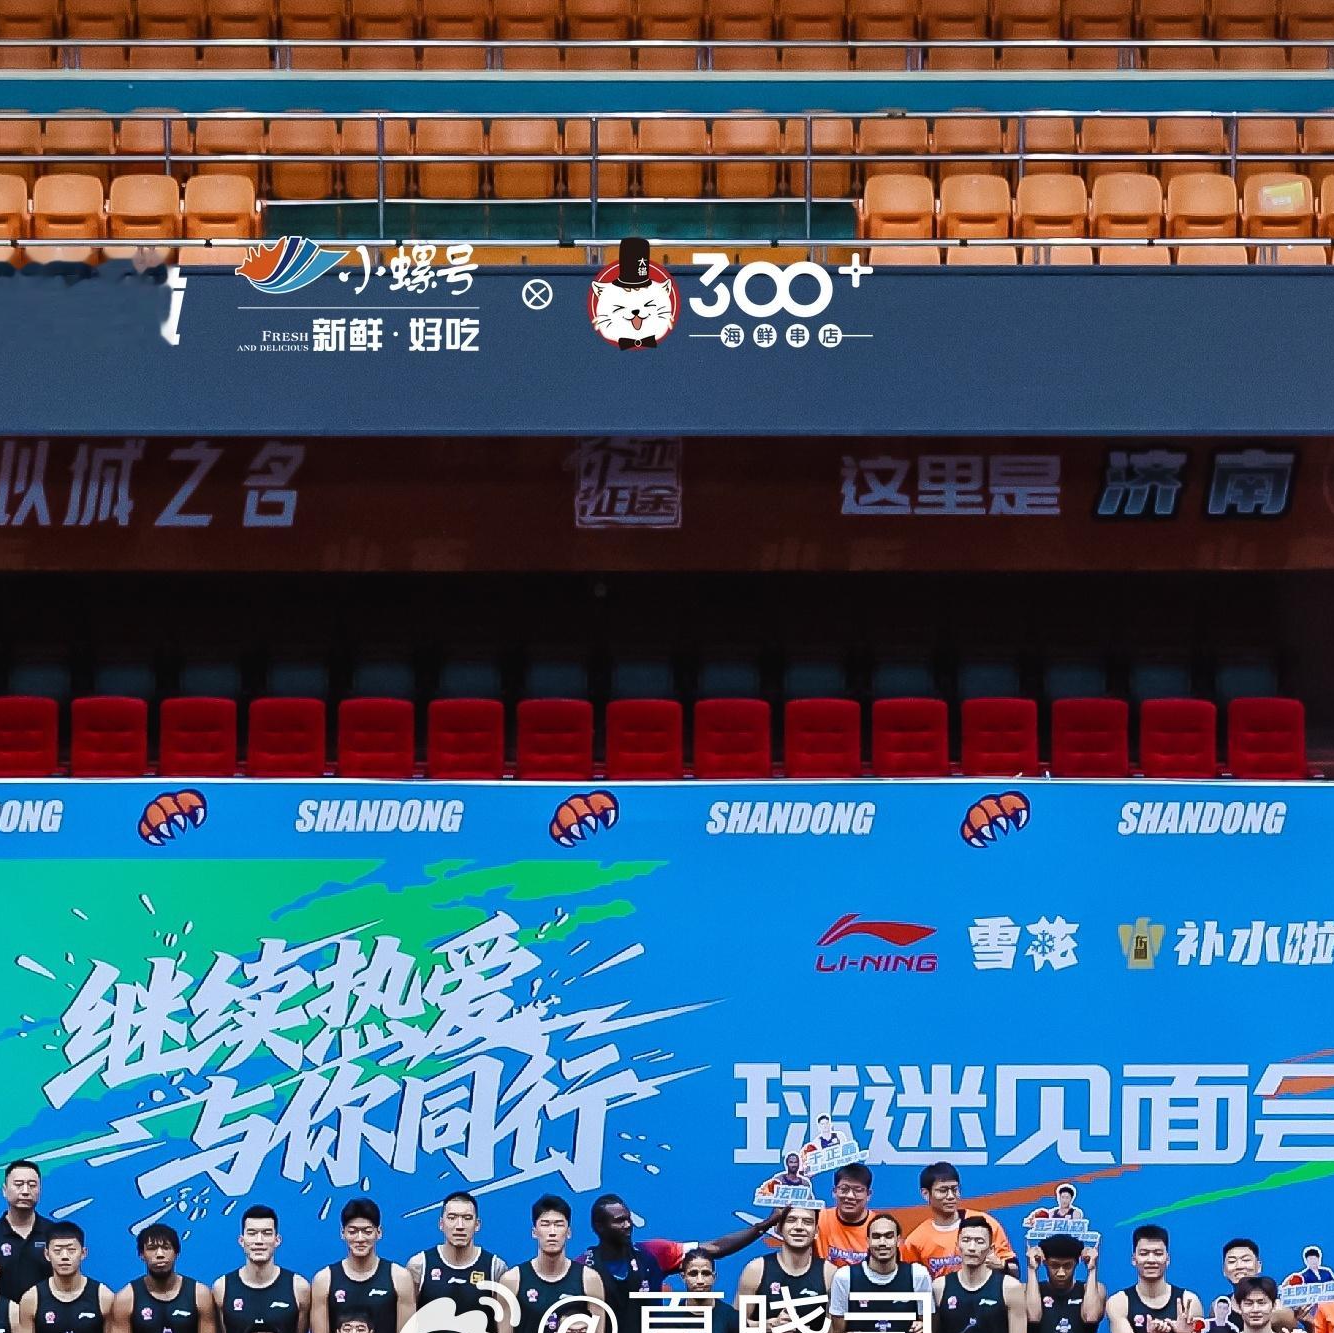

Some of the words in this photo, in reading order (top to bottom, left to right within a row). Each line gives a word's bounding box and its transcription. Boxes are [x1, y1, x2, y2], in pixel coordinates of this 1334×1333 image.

[840, 455, 1062, 516] 这里是
[1097, 452, 1294, 516] 济南
[295, 800, 464, 834] SHANDONG
[706, 800, 875, 834] SHANDONG
[1118, 800, 1287, 834] SHANDONG
[815, 954, 939, 973] LI-NING
[967, 916, 1081, 972] 雪花
[45, 912, 555, 1109] 继续热爱
[117, 1045, 637, 1198] 与你同行
